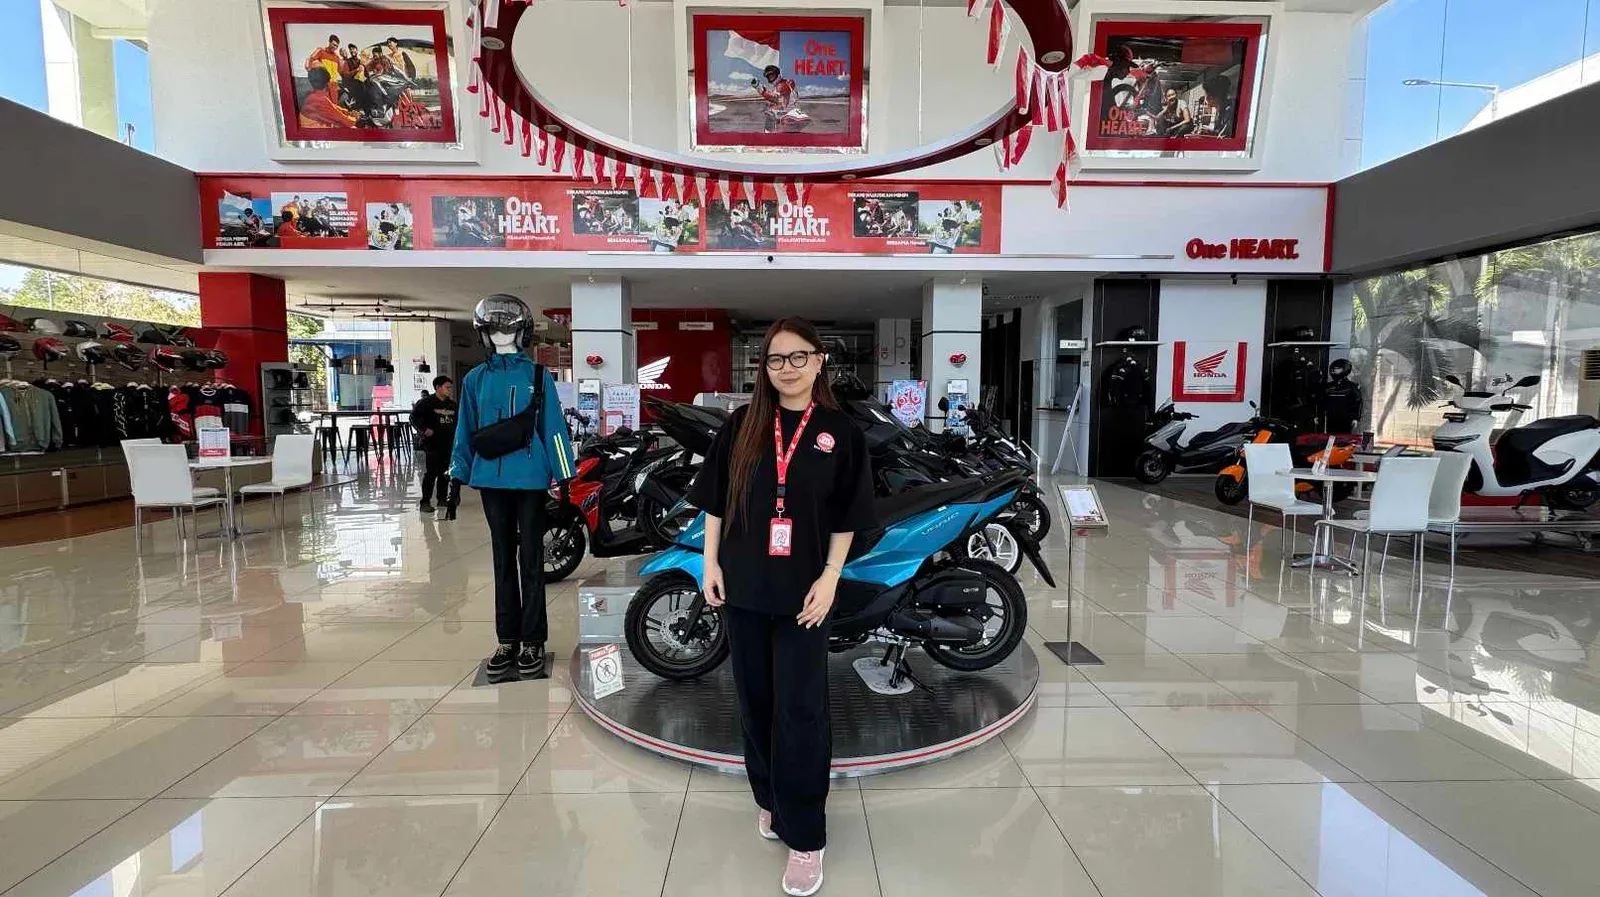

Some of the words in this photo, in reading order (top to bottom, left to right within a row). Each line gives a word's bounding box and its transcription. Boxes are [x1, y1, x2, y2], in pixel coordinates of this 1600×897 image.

[805, 39, 837, 56] One
[506, 196, 542, 215] One
[778, 202, 814, 218] One
[498, 214, 561, 234] HEART.
[769, 218, 831, 236] HEART.
[1185, 238, 1227, 259] One
